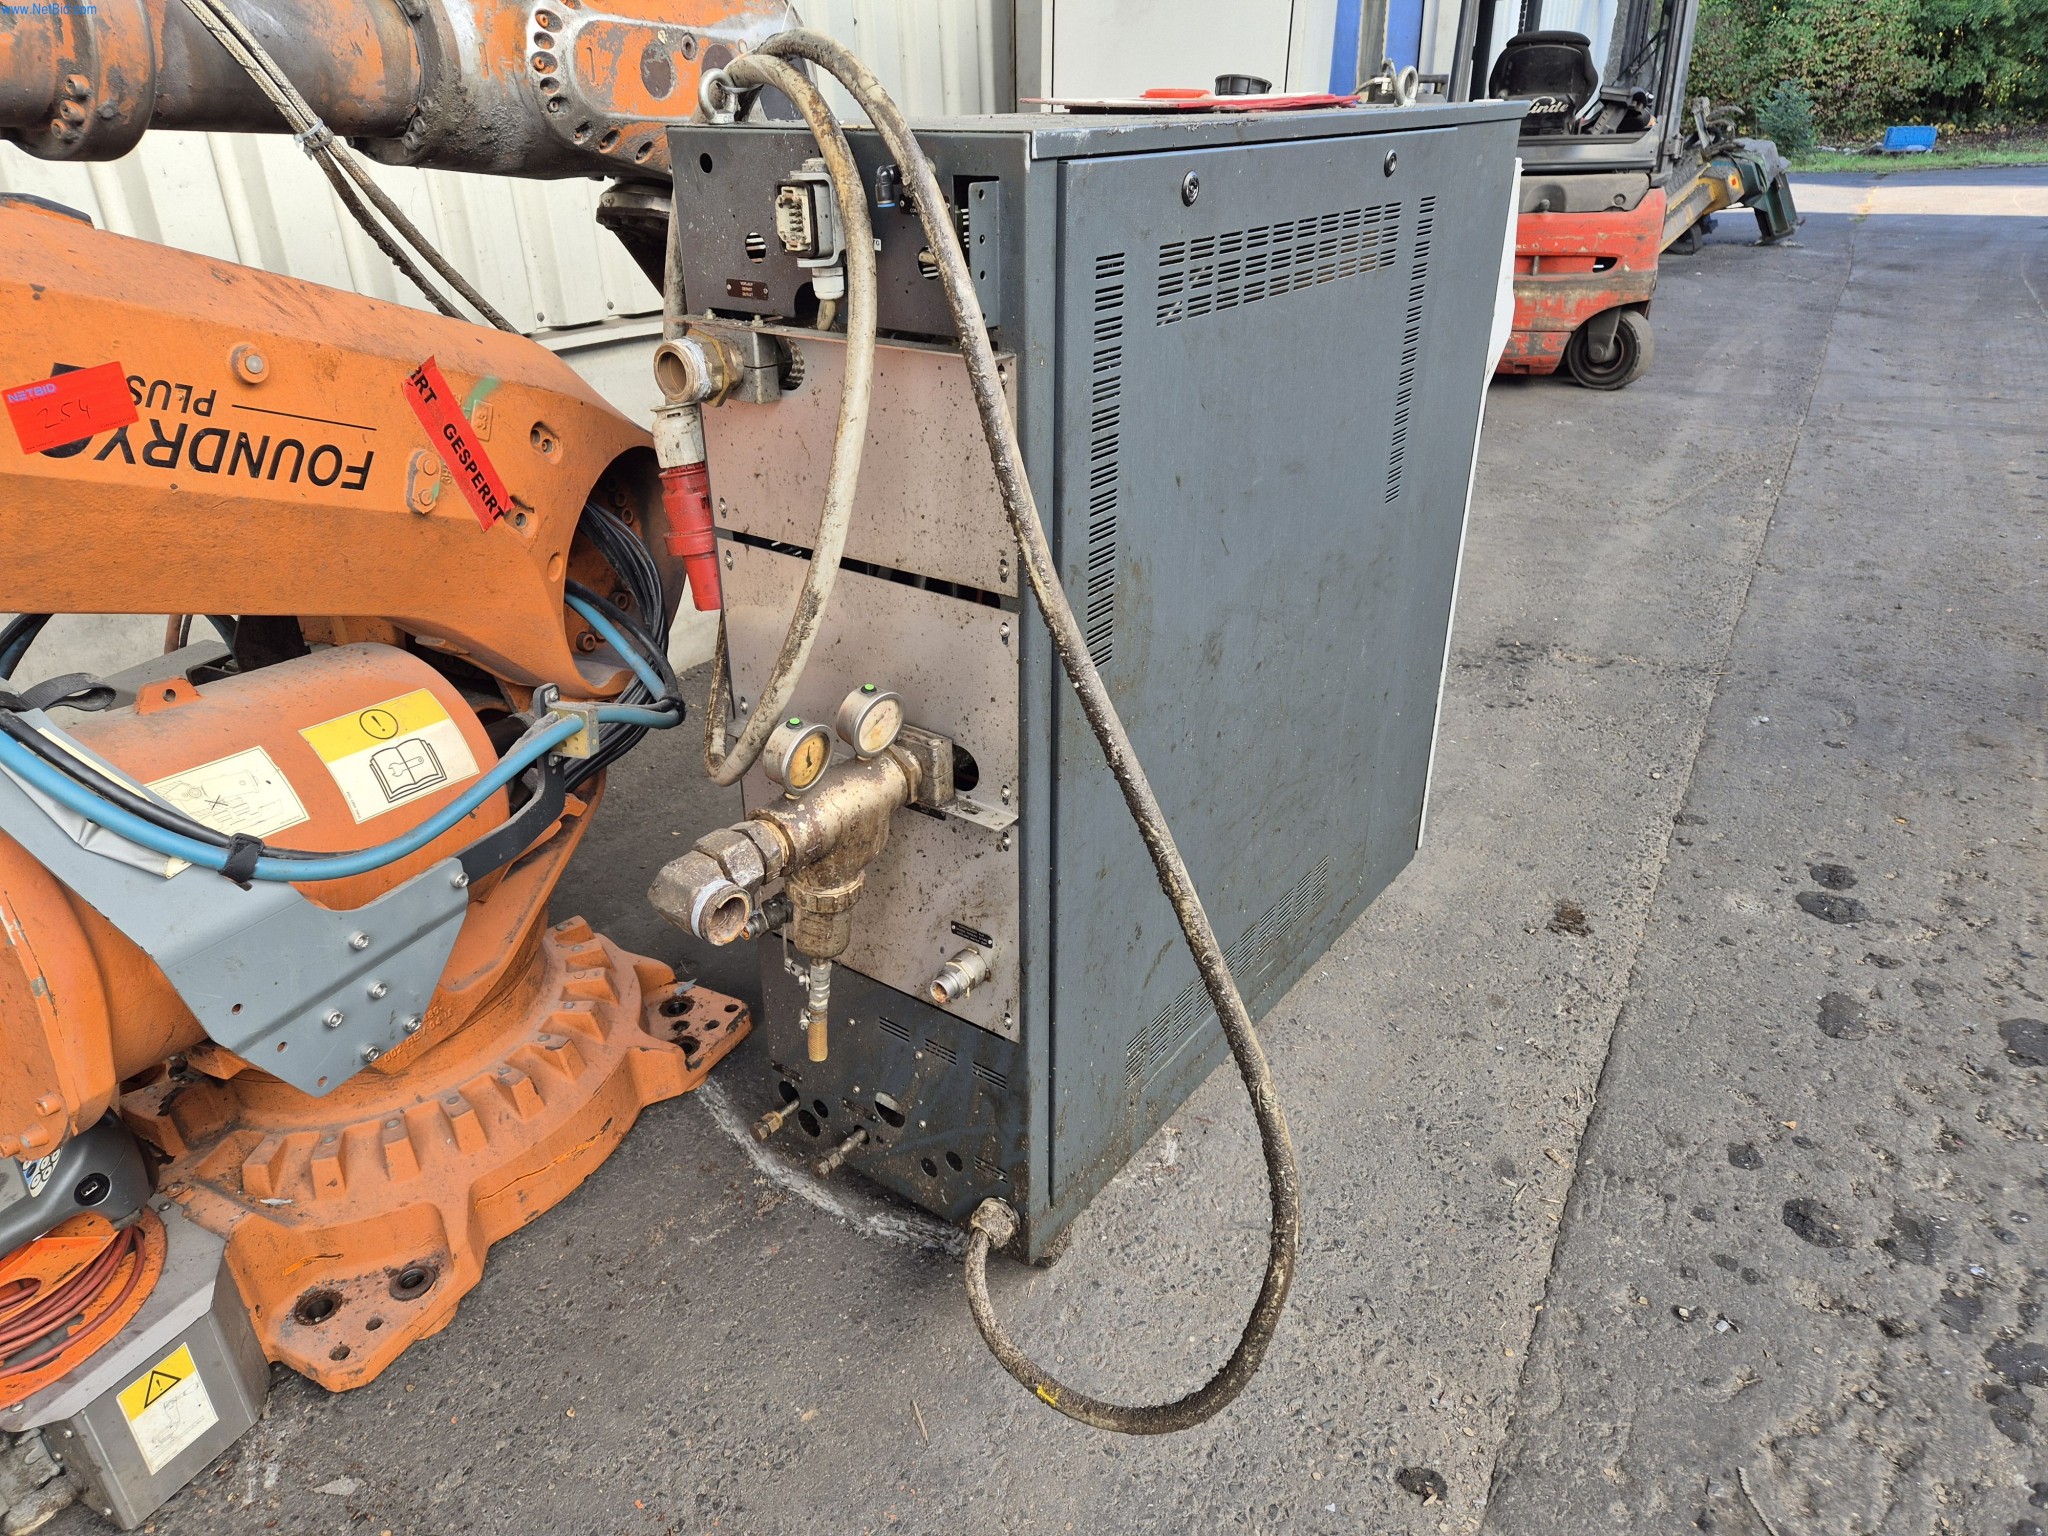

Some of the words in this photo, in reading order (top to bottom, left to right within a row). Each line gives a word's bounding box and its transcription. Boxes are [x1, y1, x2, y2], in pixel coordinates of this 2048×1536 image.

[1528, 96, 1569, 114] Linde
[7, 383, 57, 404] NETBID
[126, 374, 217, 417] PLUS
[37, 399, 91, 429] 254
[93, 418, 374, 490] FOUNDRY
[443, 423, 505, 521] GESPERRT
